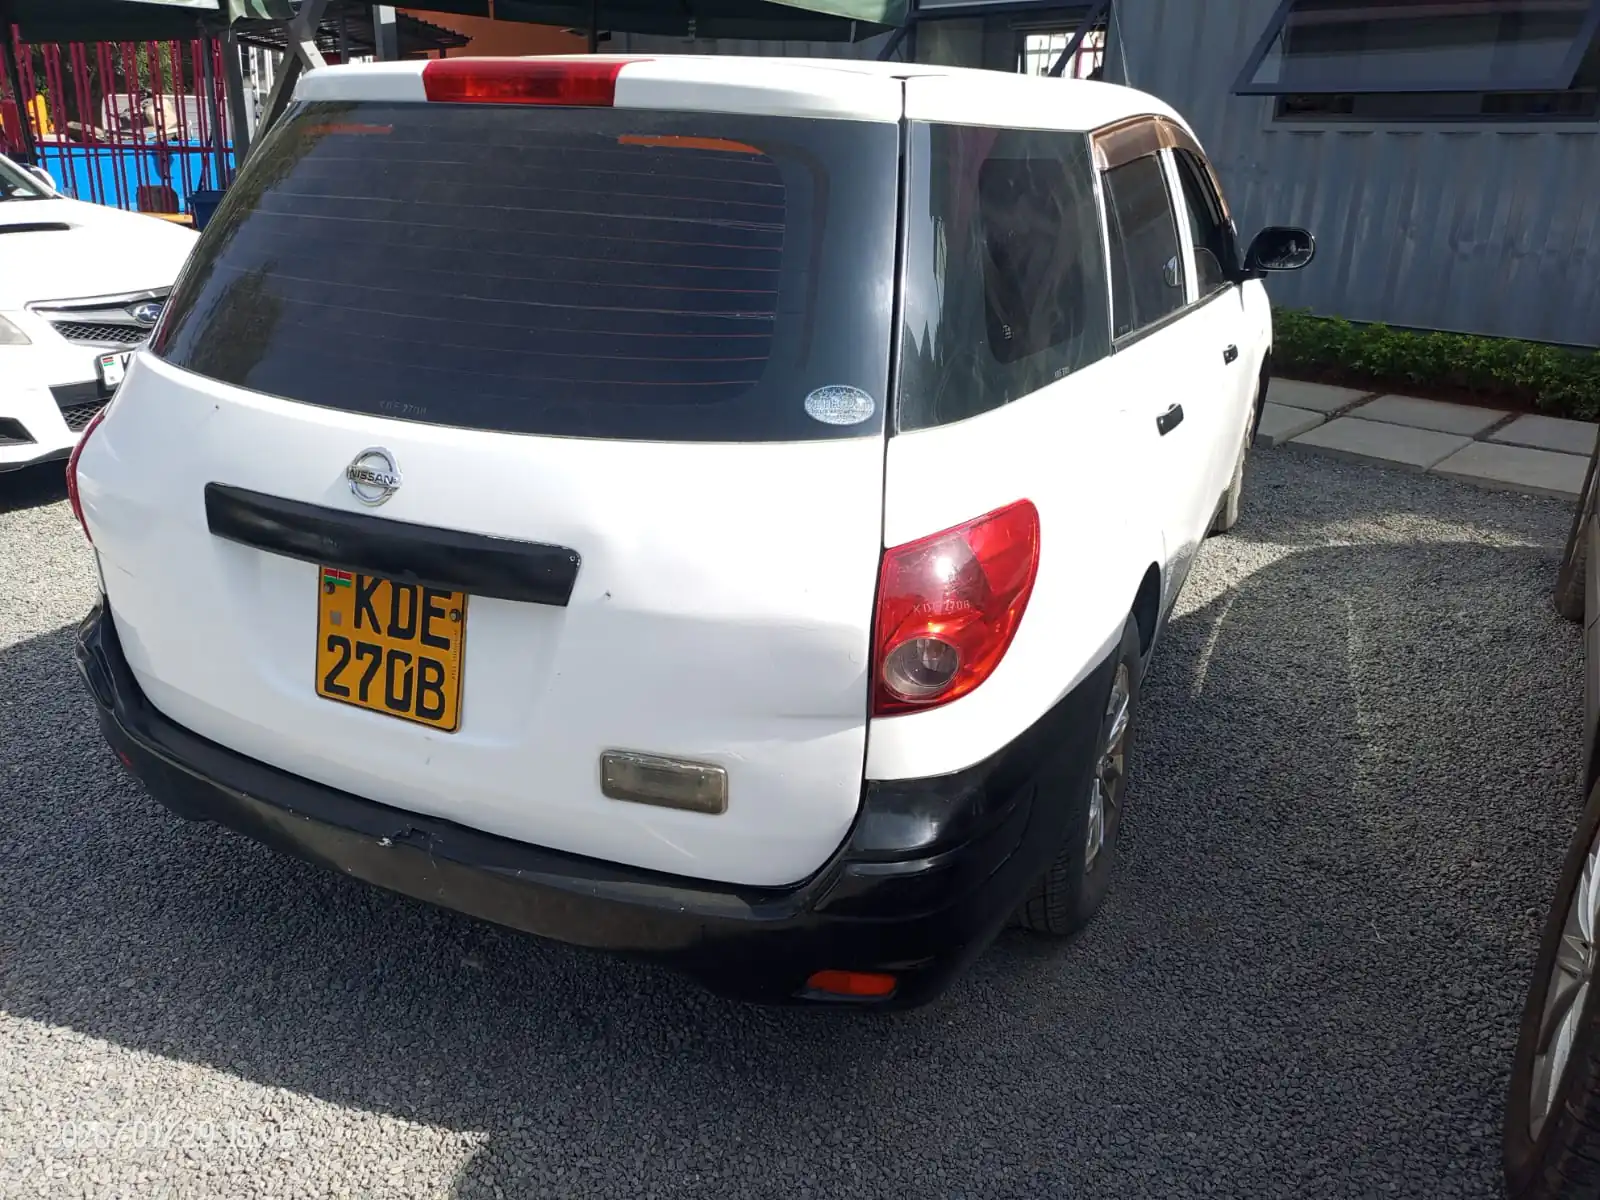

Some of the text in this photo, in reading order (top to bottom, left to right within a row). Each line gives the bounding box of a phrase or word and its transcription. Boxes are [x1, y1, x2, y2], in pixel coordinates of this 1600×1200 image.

[349, 467, 394, 485] NISSAN
[354, 573, 453, 651] KDE
[323, 634, 446, 721] 270B
